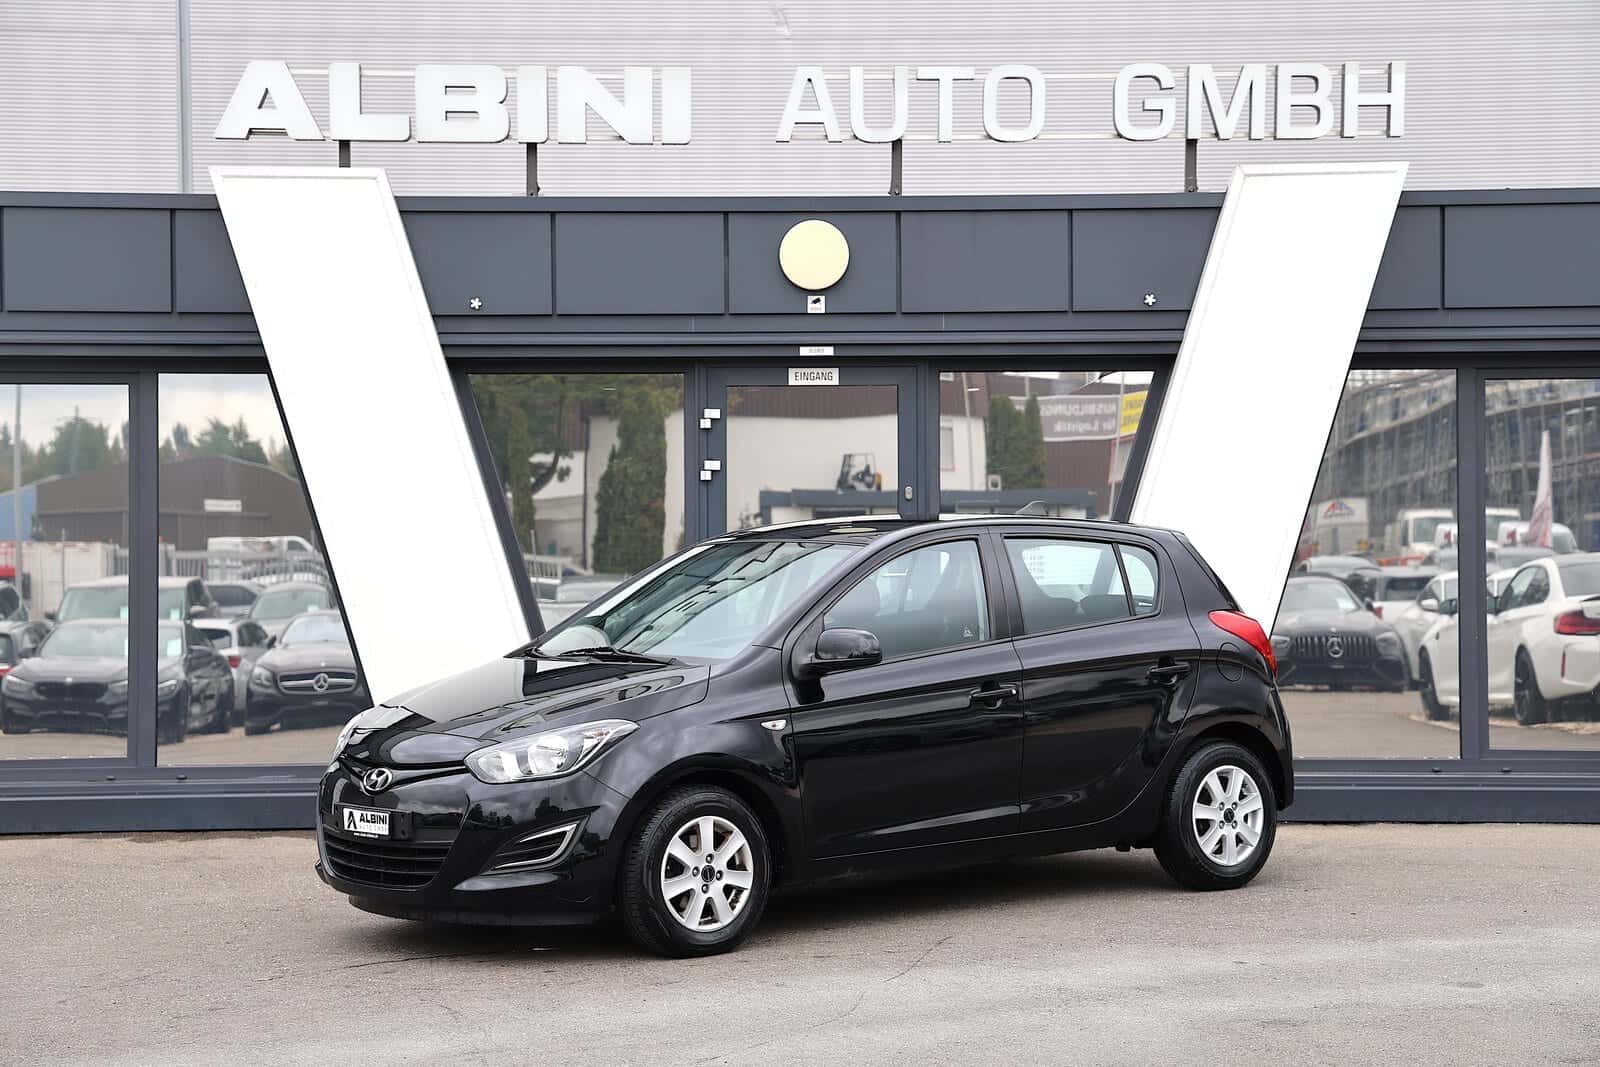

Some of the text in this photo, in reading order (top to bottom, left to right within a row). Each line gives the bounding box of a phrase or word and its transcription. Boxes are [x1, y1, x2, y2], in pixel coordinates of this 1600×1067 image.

[215, 60, 1407, 145] ALBINI AUTO GMBH
[794, 371, 833, 381] EINGANG
[359, 813, 387, 824] ALBINI
